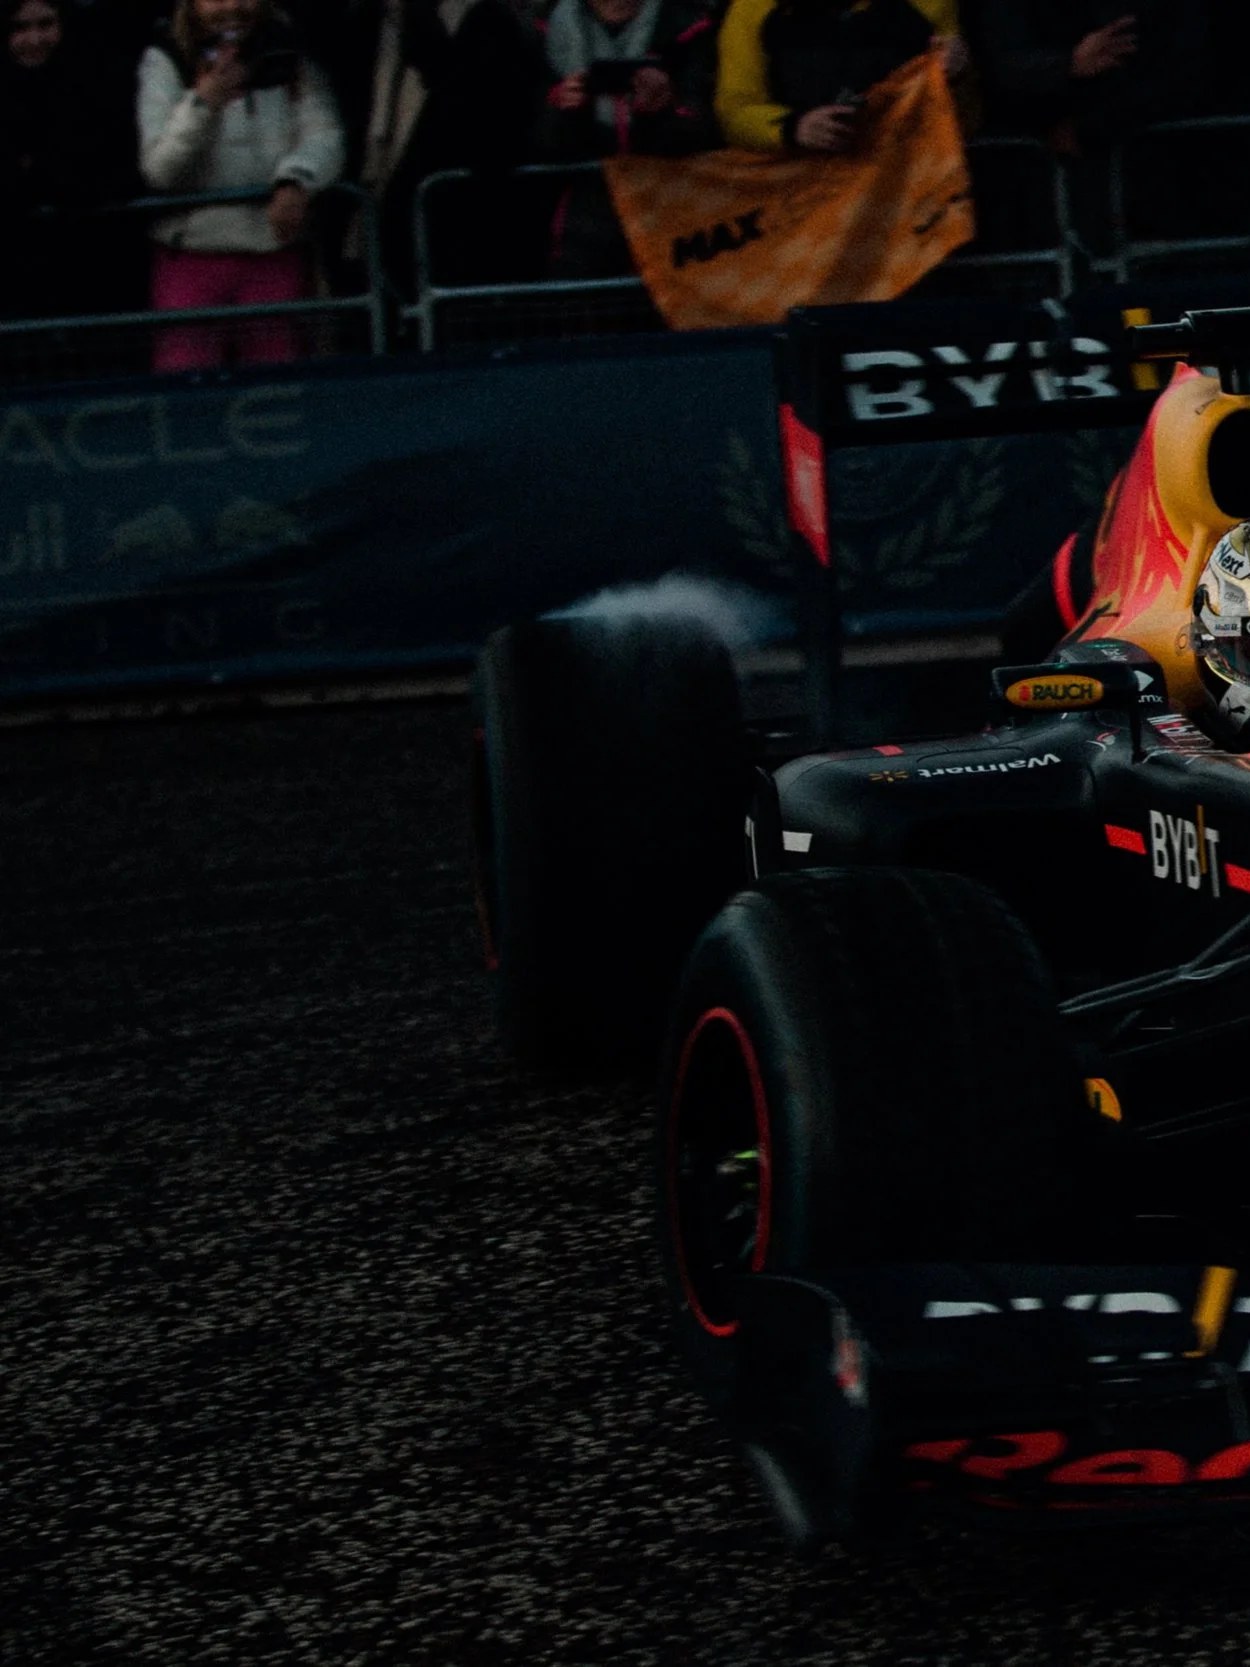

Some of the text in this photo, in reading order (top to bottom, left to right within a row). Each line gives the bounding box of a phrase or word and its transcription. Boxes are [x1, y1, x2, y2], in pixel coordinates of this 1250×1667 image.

[672, 209, 763, 268] MAX
[1032, 682, 1093, 701] RAUCH
[919, 752, 1062, 779] Walmart
[1148, 803, 1221, 899] BYBIT
